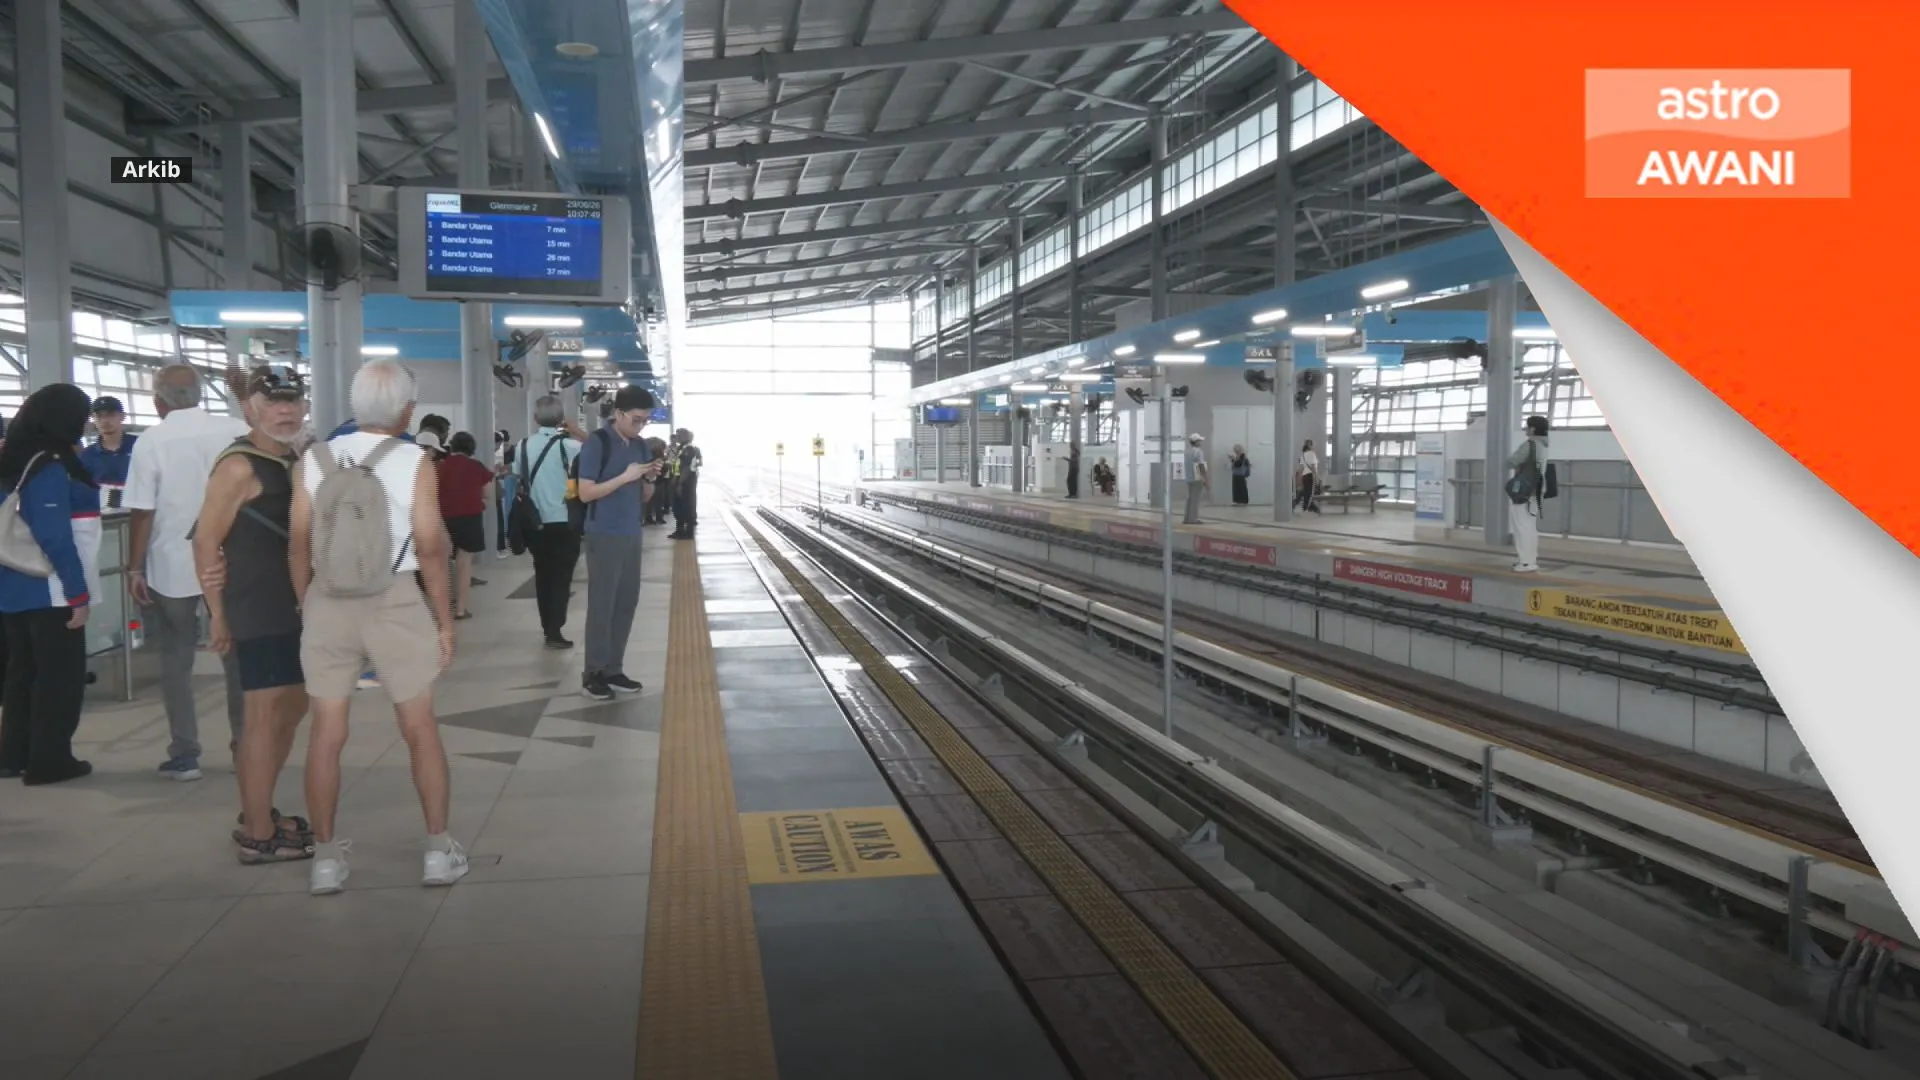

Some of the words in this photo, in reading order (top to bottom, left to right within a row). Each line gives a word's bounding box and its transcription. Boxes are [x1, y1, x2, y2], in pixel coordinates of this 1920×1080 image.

[490, 202, 531, 211] Glenmarie
[532, 203, 538, 211] 2
[441, 221, 467, 230] Bandar
[468, 223, 493, 231] Utama
[428, 235, 433, 243] 2
[441, 235, 468, 244] Bandar
[468, 236, 493, 245] Utama
[557, 240, 570, 248] min
[441, 249, 468, 258] Bandar
[468, 251, 493, 259] Utama
[441, 264, 468, 272] Bandar
[468, 265, 493, 273] Utama
[1394, 572, 1423, 586] VOLTAGE
[1424, 576, 1448, 591] TRACK
[1621, 603, 1664, 619] TERJATUH
[1665, 611, 1688, 625] ATAS
[1690, 615, 1718, 630] TREK?
[1553, 606, 1577, 618] TEKAN
[1611, 616, 1653, 632] INTERKOM
[1655, 625, 1685, 639] UNTUK
[1687, 630, 1733, 648] BANTUAN
[782, 815, 838, 873] CAUTION
[844, 820, 901, 861] AWAS
